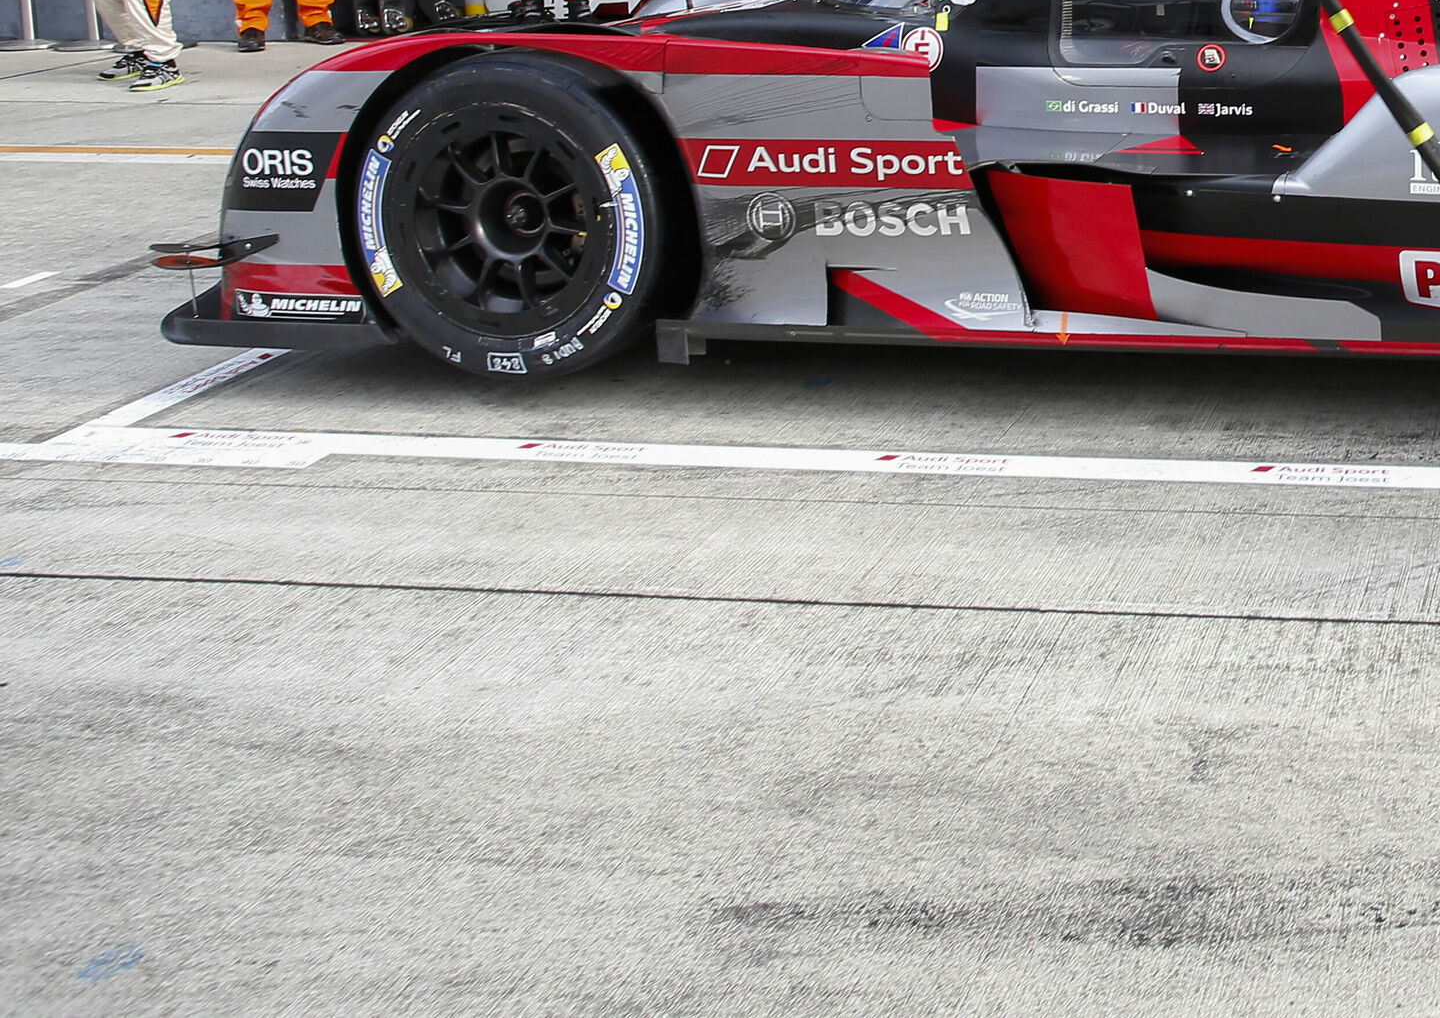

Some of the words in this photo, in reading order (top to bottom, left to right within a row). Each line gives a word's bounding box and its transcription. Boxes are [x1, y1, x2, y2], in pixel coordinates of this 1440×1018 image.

[1063, 100, 1075, 112] di
[1079, 100, 1119, 114] Grassi
[1149, 102, 1187, 115] Duval
[1215, 103, 1253, 117] Jarvis
[242, 148, 314, 177] ORIS
[746, 146, 837, 173] Audi
[850, 147, 963, 182] Sport
[242, 176, 270, 190] Swiss
[272, 177, 316, 190] Watches
[361, 155, 381, 251] MICHELIN
[814, 203, 972, 237] BOSCH
[616, 192, 639, 289] MICHELIN
[973, 292, 1009, 303] ACTION
[270, 297, 362, 313] MICHELIN
[970, 302, 992, 310] ROAD
[992, 303, 1023, 311] SAFETY
[442, 345, 463, 363] FL
[198, 432, 241, 440] Audi
[246, 433, 297, 442] Sport
[545, 442, 587, 451] Audi
[591, 443, 648, 453] Sport
[902, 455, 949, 463] Audi
[953, 456, 1009, 465] Sport
[898, 463, 949, 471] Team
[955, 464, 1007, 472] Joest
[1278, 465, 1326, 473] Audi
[1331, 466, 1391, 475] Sport
[1278, 474, 1331, 482] Team
[1336, 475, 1390, 483] Joest
